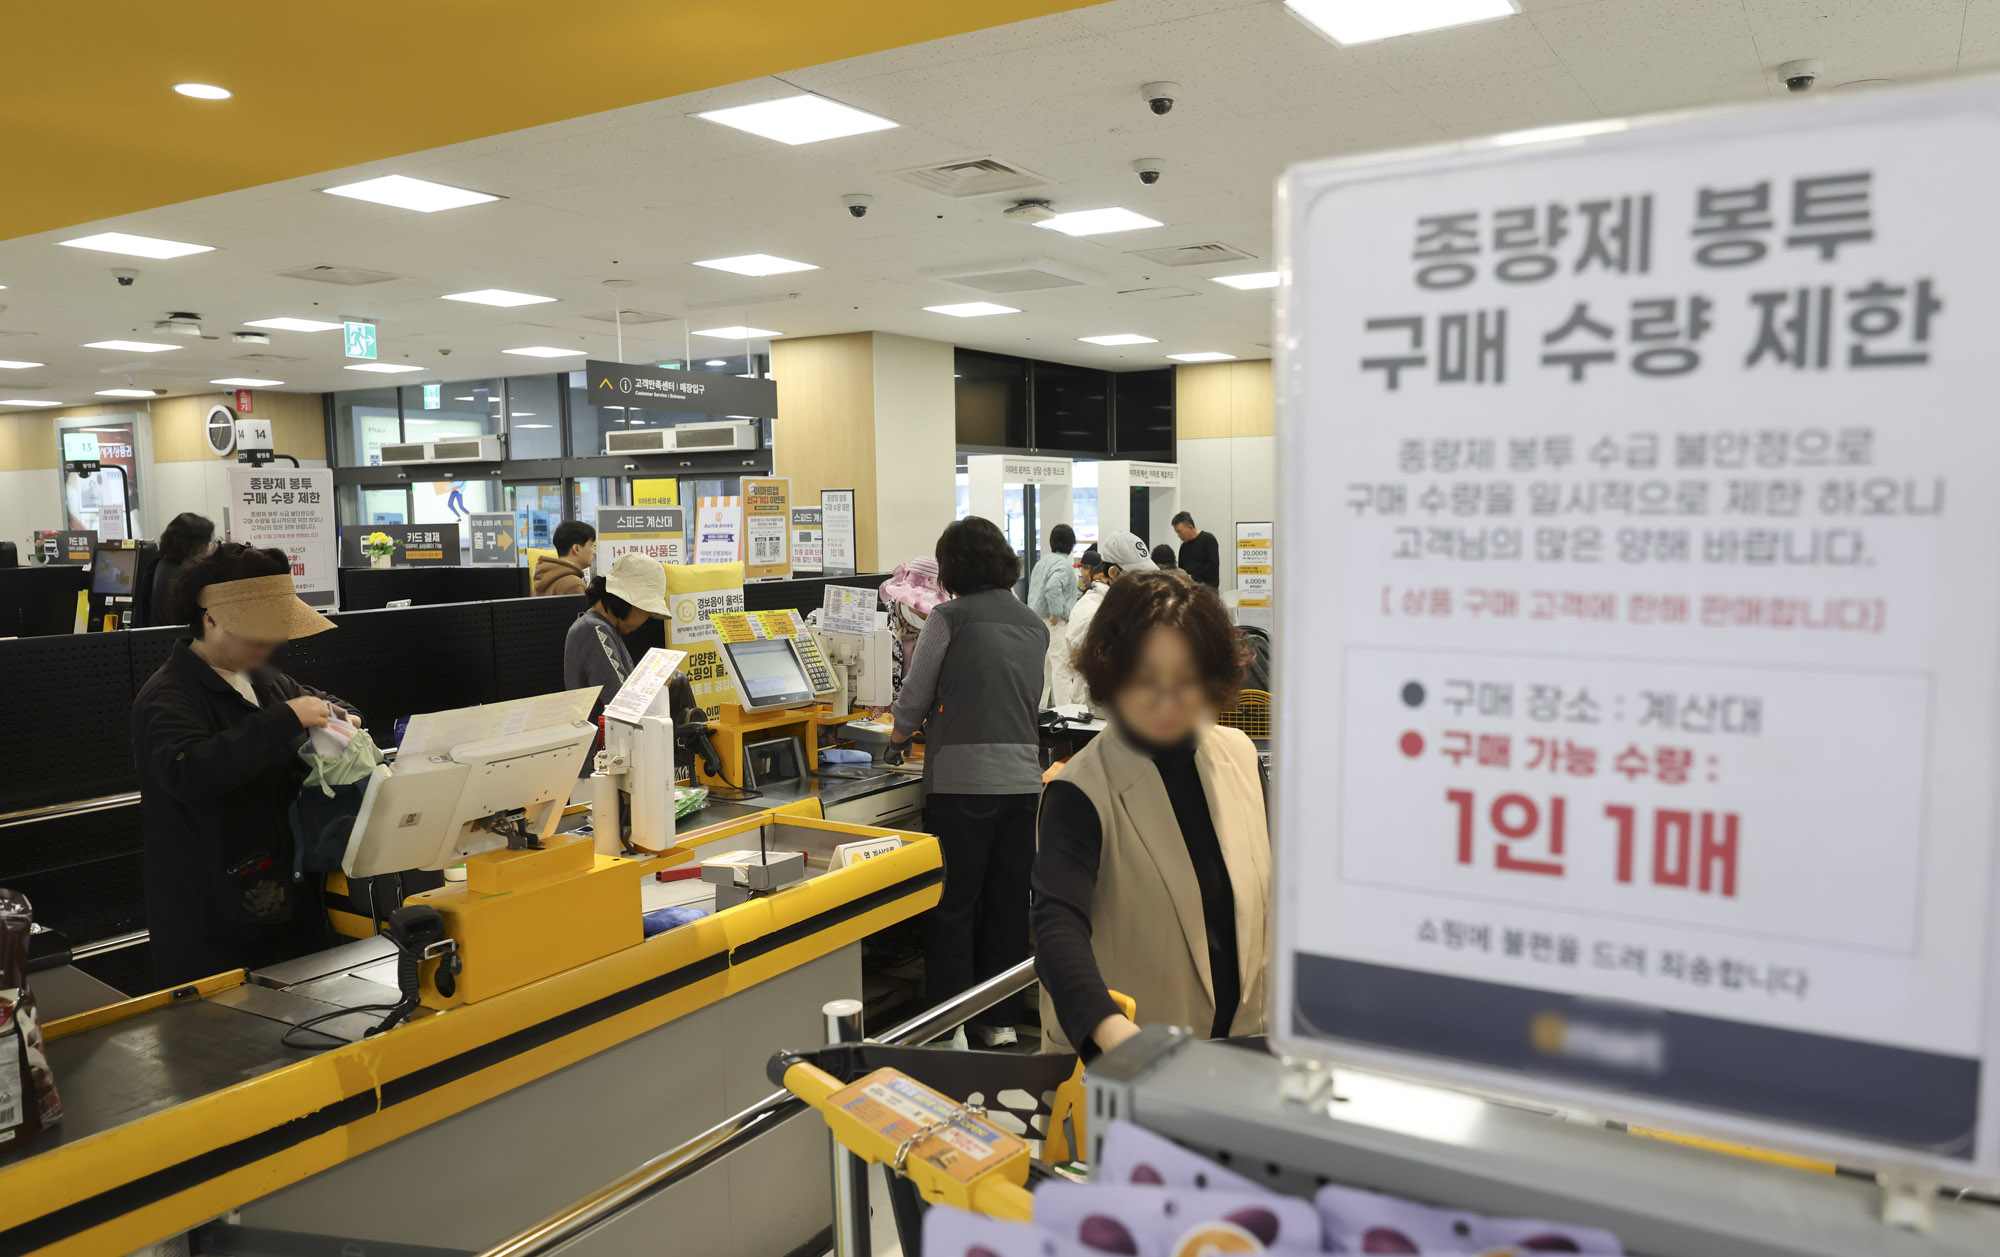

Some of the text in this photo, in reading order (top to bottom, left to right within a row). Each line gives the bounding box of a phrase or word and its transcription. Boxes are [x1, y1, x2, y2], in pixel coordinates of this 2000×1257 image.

[1412, 171, 1874, 291] 종량제 봉투
[1361, 279, 1942, 391] 구매 수량 제한
[635, 378, 705, 395] 고객만족센터 매장입구
[238, 429, 245, 439] 14
[255, 429, 266, 439] 14
[82, 442, 92, 452] 13
[1398, 427, 1874, 474] 종량제 봉투 수급 불안정으로
[250, 477, 312, 490] 종량제 봉투
[243, 491, 320, 505] 구매 수량 제한
[754, 486, 779, 496] 이마트앱
[1346, 475, 1945, 517] 구매 수량을 일시적으로 제한 하오니
[770, 495, 785, 504] 이벤트
[617, 516, 672, 528] 스피드 계산대
[794, 513, 812, 522] 스피드
[407, 531, 440, 542] 카드 결제
[612, 546, 626, 557] 1+1
[1136, 542, 1147, 557] S
[1392, 526, 1523, 561] 고객님의
[1534, 525, 1604, 563] 많은
[1616, 525, 1690, 564] 양해
[698, 596, 724, 610] 경보음이
[1402, 587, 1452, 617] 상품
[1463, 587, 1519, 618] 구매
[1529, 589, 1617, 621] 고객에
[1627, 592, 1688, 624] 한해
[689, 651, 717, 667] 다양한
[716, 664, 728, 677] 즐
[1444, 680, 1514, 717] 구매
[1527, 683, 1600, 724] 장소
[1639, 689, 1763, 735] 계산대
[1443, 730, 1511, 769] 구매
[1525, 736, 1598, 777] 가능
[1613, 744, 1693, 785] 수량
[1446, 788, 1740, 898] 1인 1매
[1416, 918, 1811, 999] 쇼핑에 불편을 드려 죄송합니다
